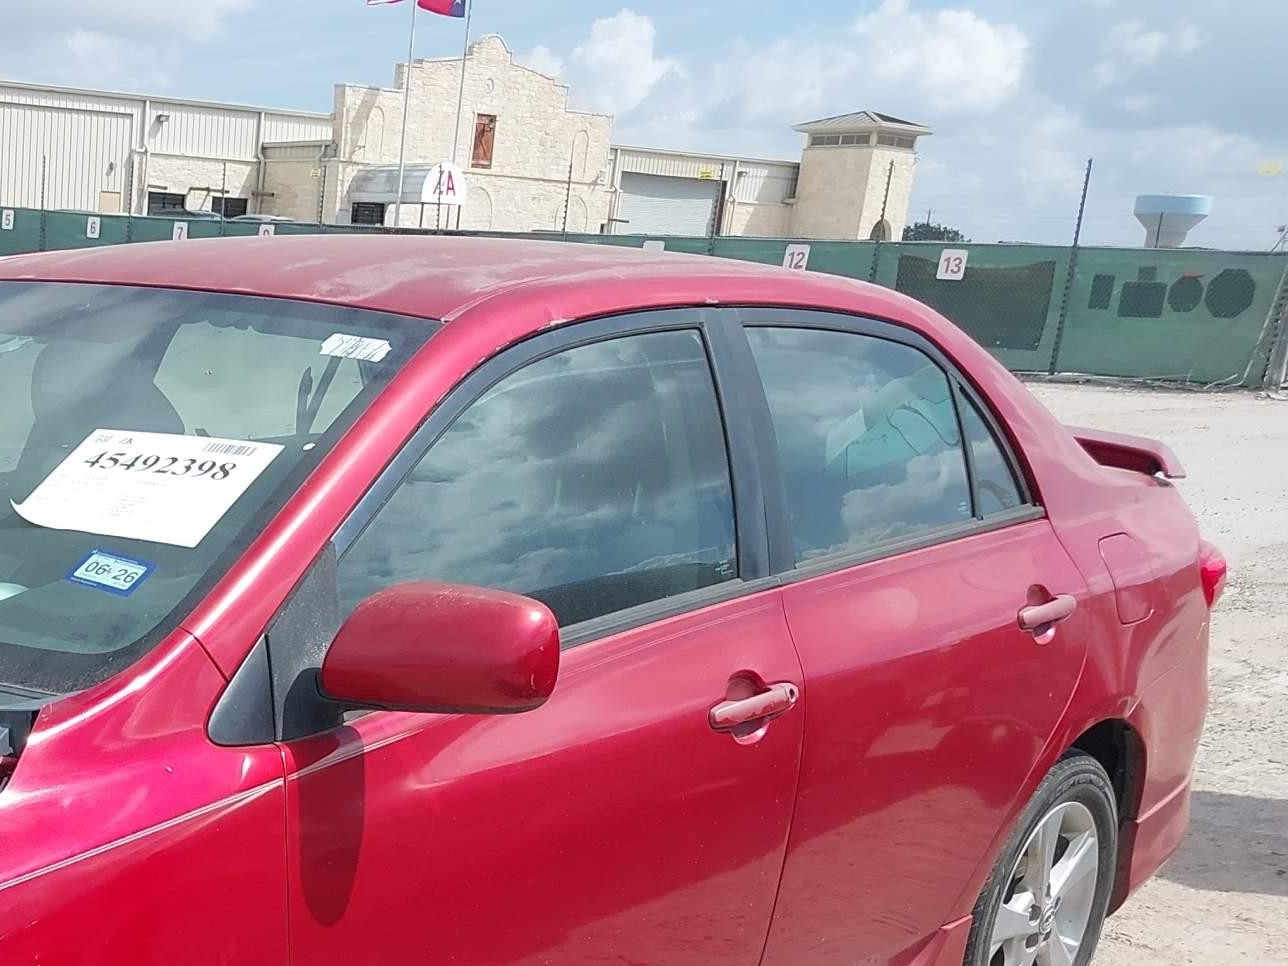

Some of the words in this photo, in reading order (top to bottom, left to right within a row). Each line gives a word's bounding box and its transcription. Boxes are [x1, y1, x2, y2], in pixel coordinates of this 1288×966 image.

[176, 226, 184, 240] 7
[788, 251, 806, 270] 12
[943, 256, 963, 275] 13
[84, 450, 237, 481] 45492398
